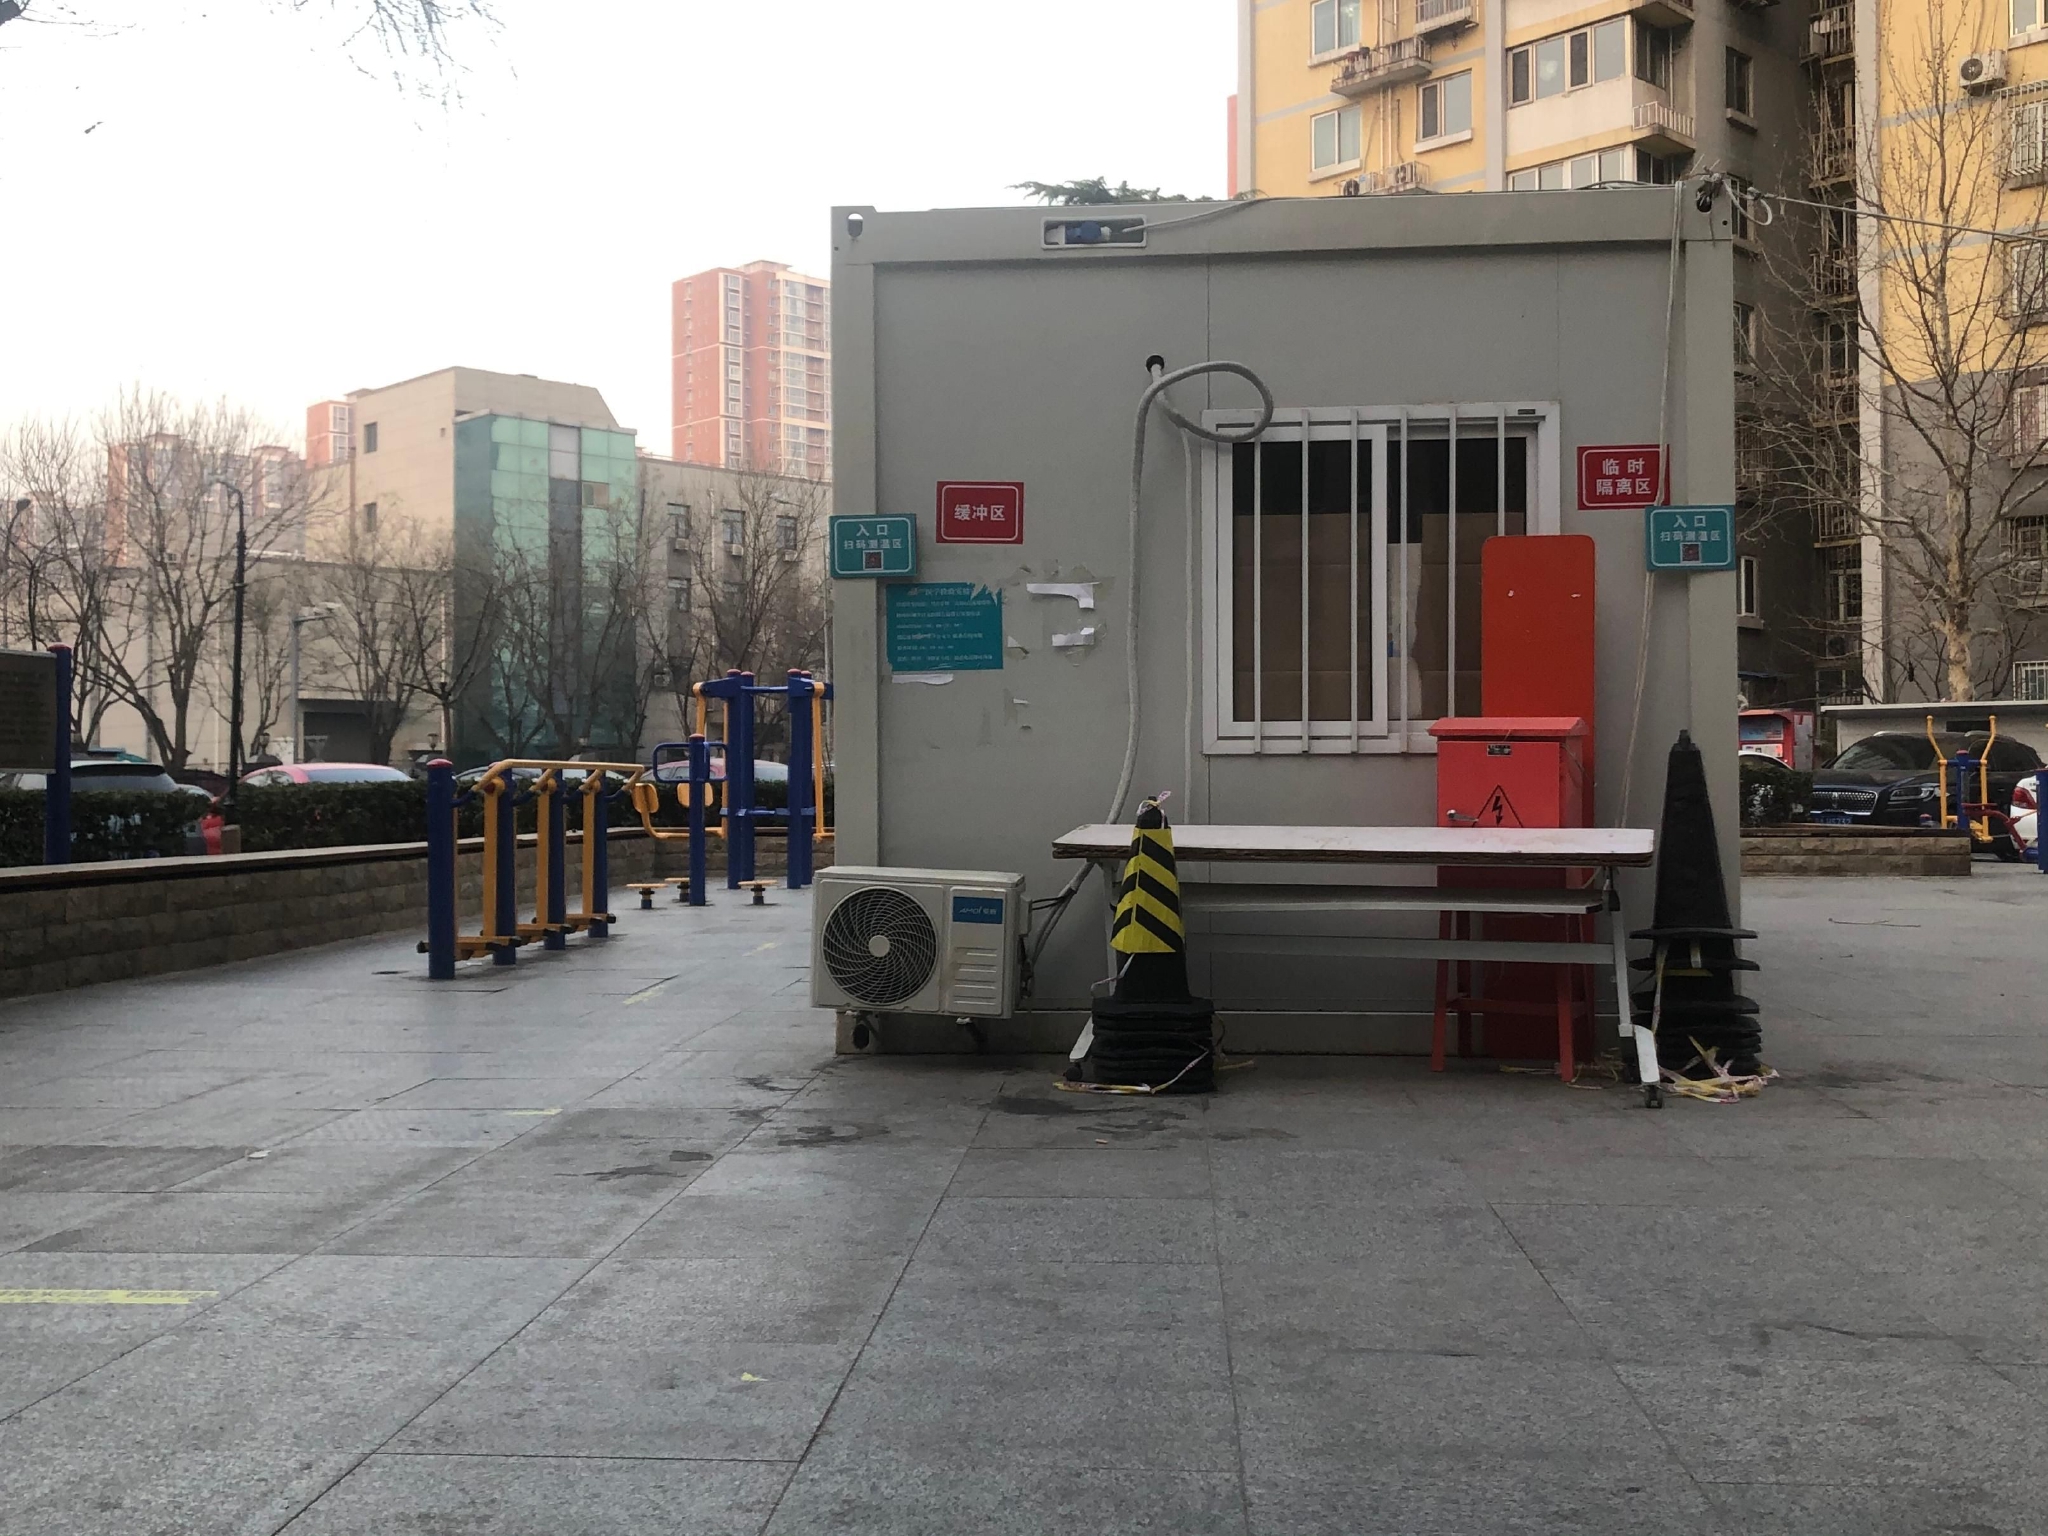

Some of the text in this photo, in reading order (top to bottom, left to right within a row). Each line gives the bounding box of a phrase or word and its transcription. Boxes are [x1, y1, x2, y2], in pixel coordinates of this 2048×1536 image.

[1602, 457, 1645, 475] 临时
[1596, 478, 1651, 495] 隔离区
[954, 504, 1005, 521] 缓冲区
[1673, 514, 1706, 528] 入口
[856, 523, 888, 536] 入口
[1660, 530, 1720, 542] 扫码测温区
[844, 538, 902, 550] 扫码测温区
